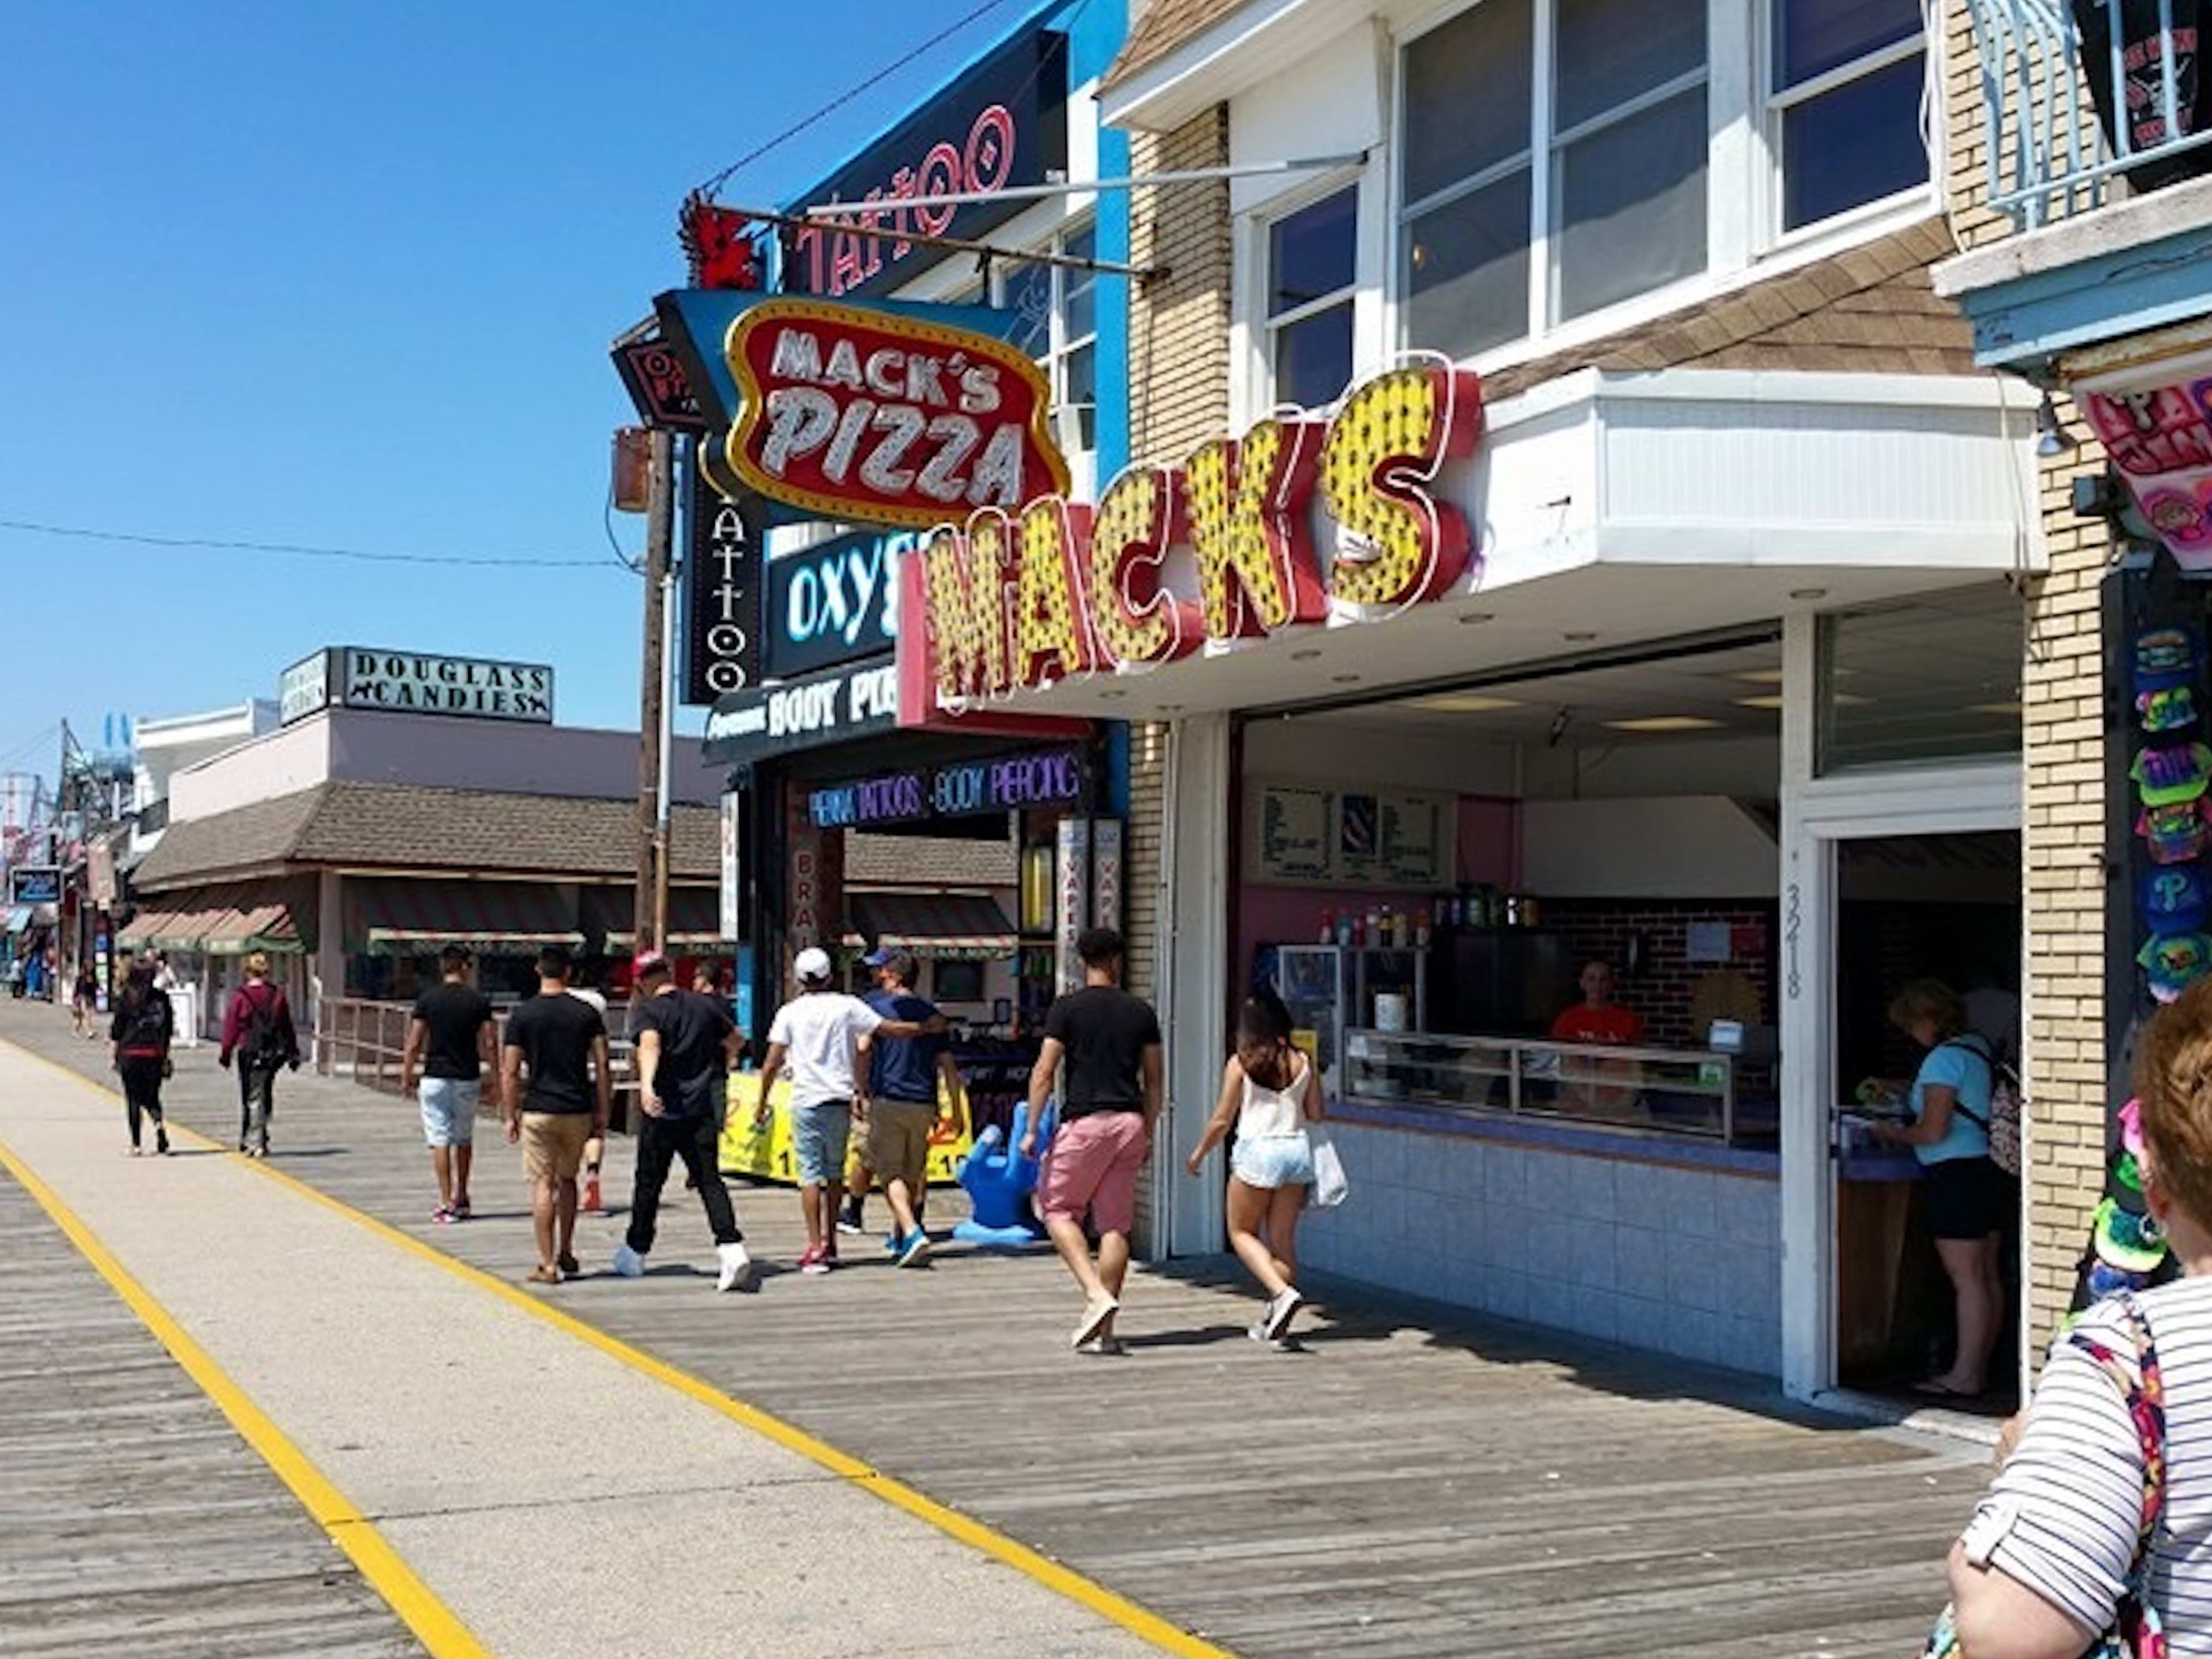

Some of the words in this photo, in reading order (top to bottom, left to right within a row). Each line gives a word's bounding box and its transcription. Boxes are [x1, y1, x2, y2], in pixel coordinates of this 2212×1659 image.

[770, 328, 1002, 414] MACK'S
[761, 386, 1024, 507] PIZZA
[923, 350, 1482, 715] MACKS
[706, 497, 747, 692] ATTOO
[355, 653, 544, 691] DOUGLASS
[374, 681, 528, 714] CANDIES
[768, 679, 842, 737] BODY
[991, 752, 1081, 806] PIERCING
